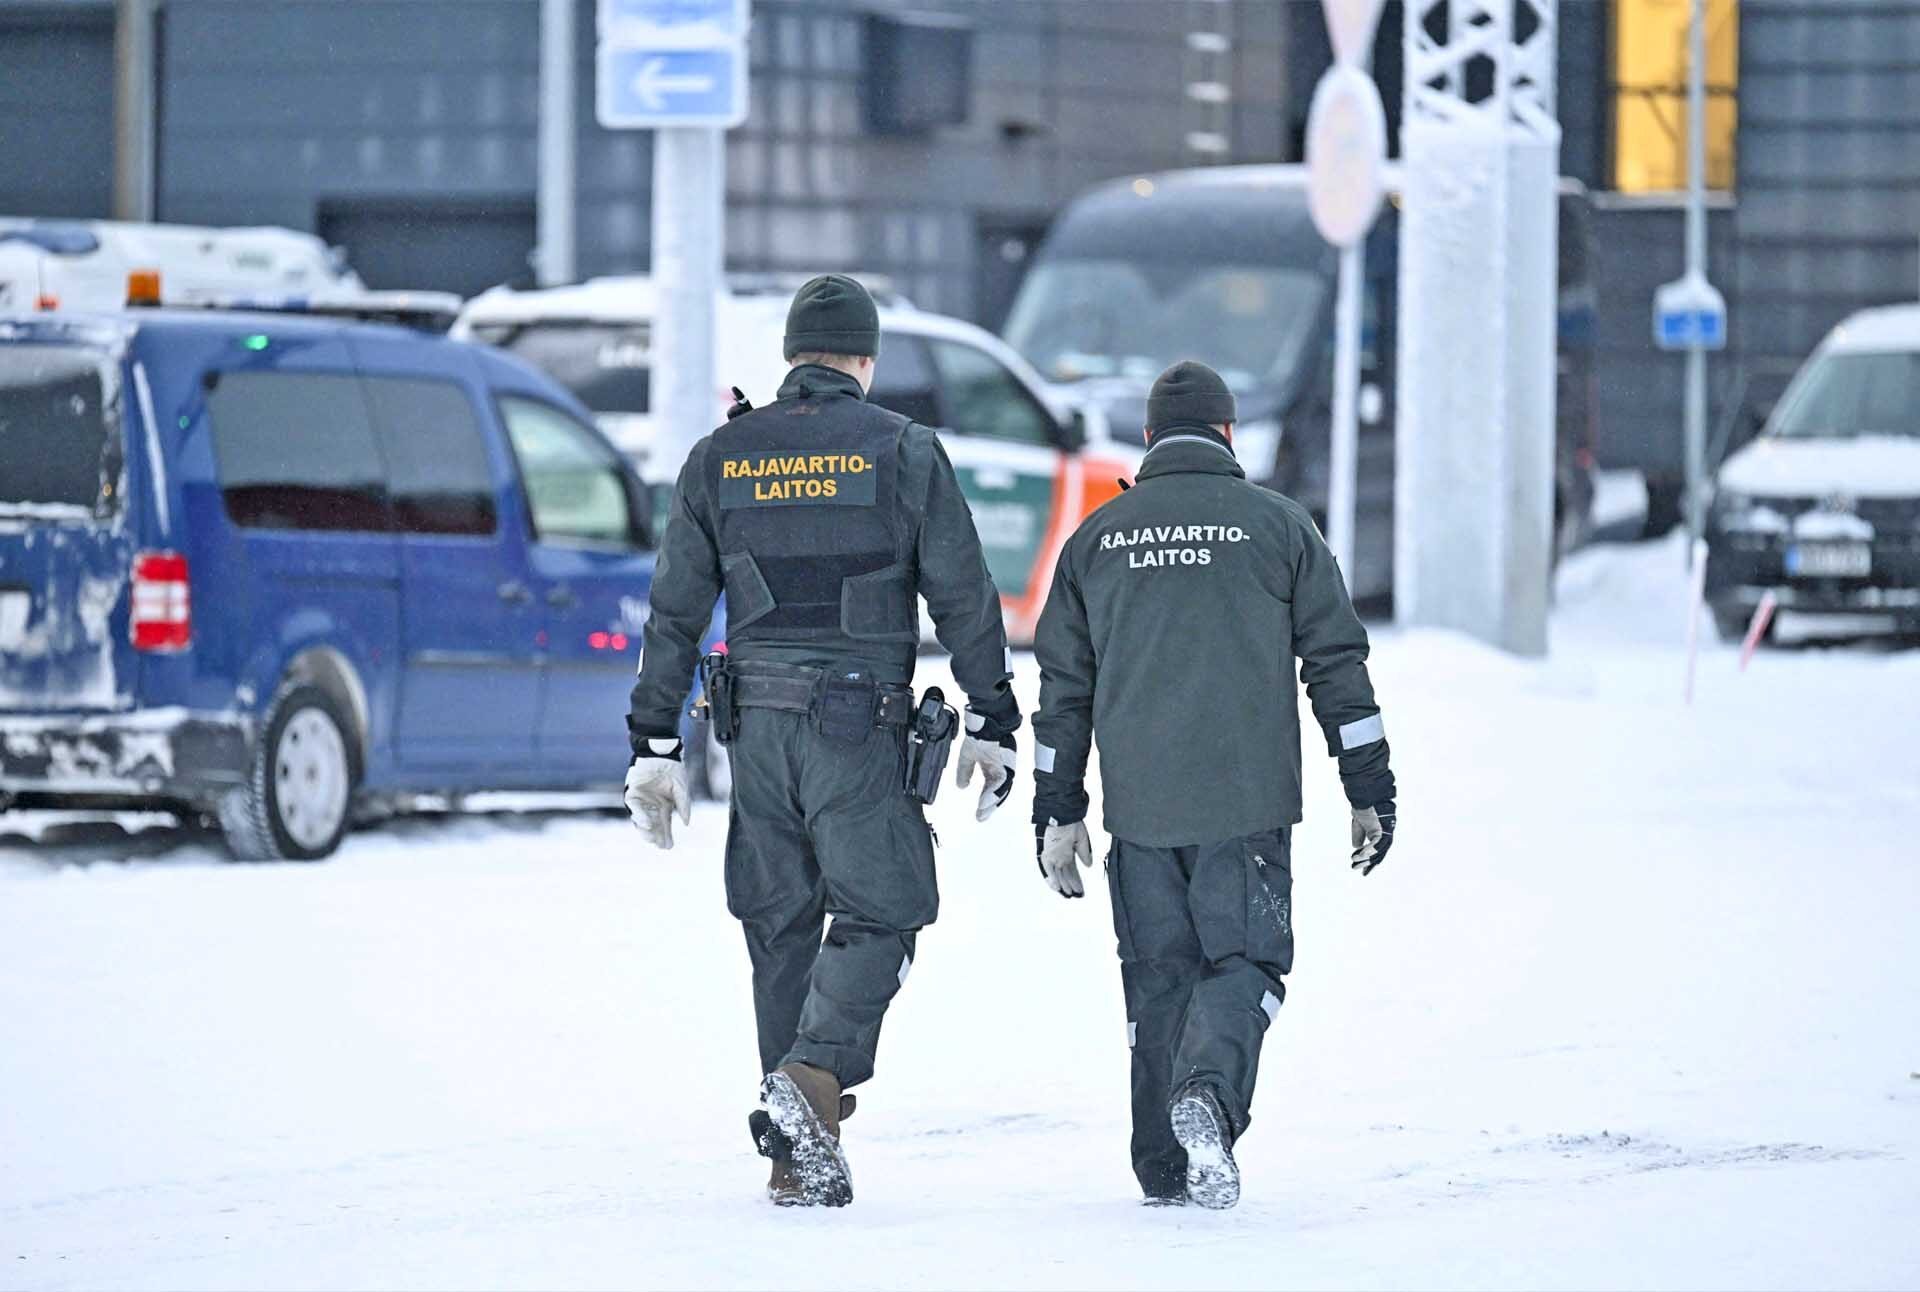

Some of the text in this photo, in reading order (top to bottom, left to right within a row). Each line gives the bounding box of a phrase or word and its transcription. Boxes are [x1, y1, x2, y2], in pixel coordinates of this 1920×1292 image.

[722, 455, 873, 479] RAJAVARTIO-
[754, 479, 837, 500] LAITOS
[1099, 525, 1251, 550] RAJAVARTIO-
[1129, 548, 1212, 568] LAITOS
